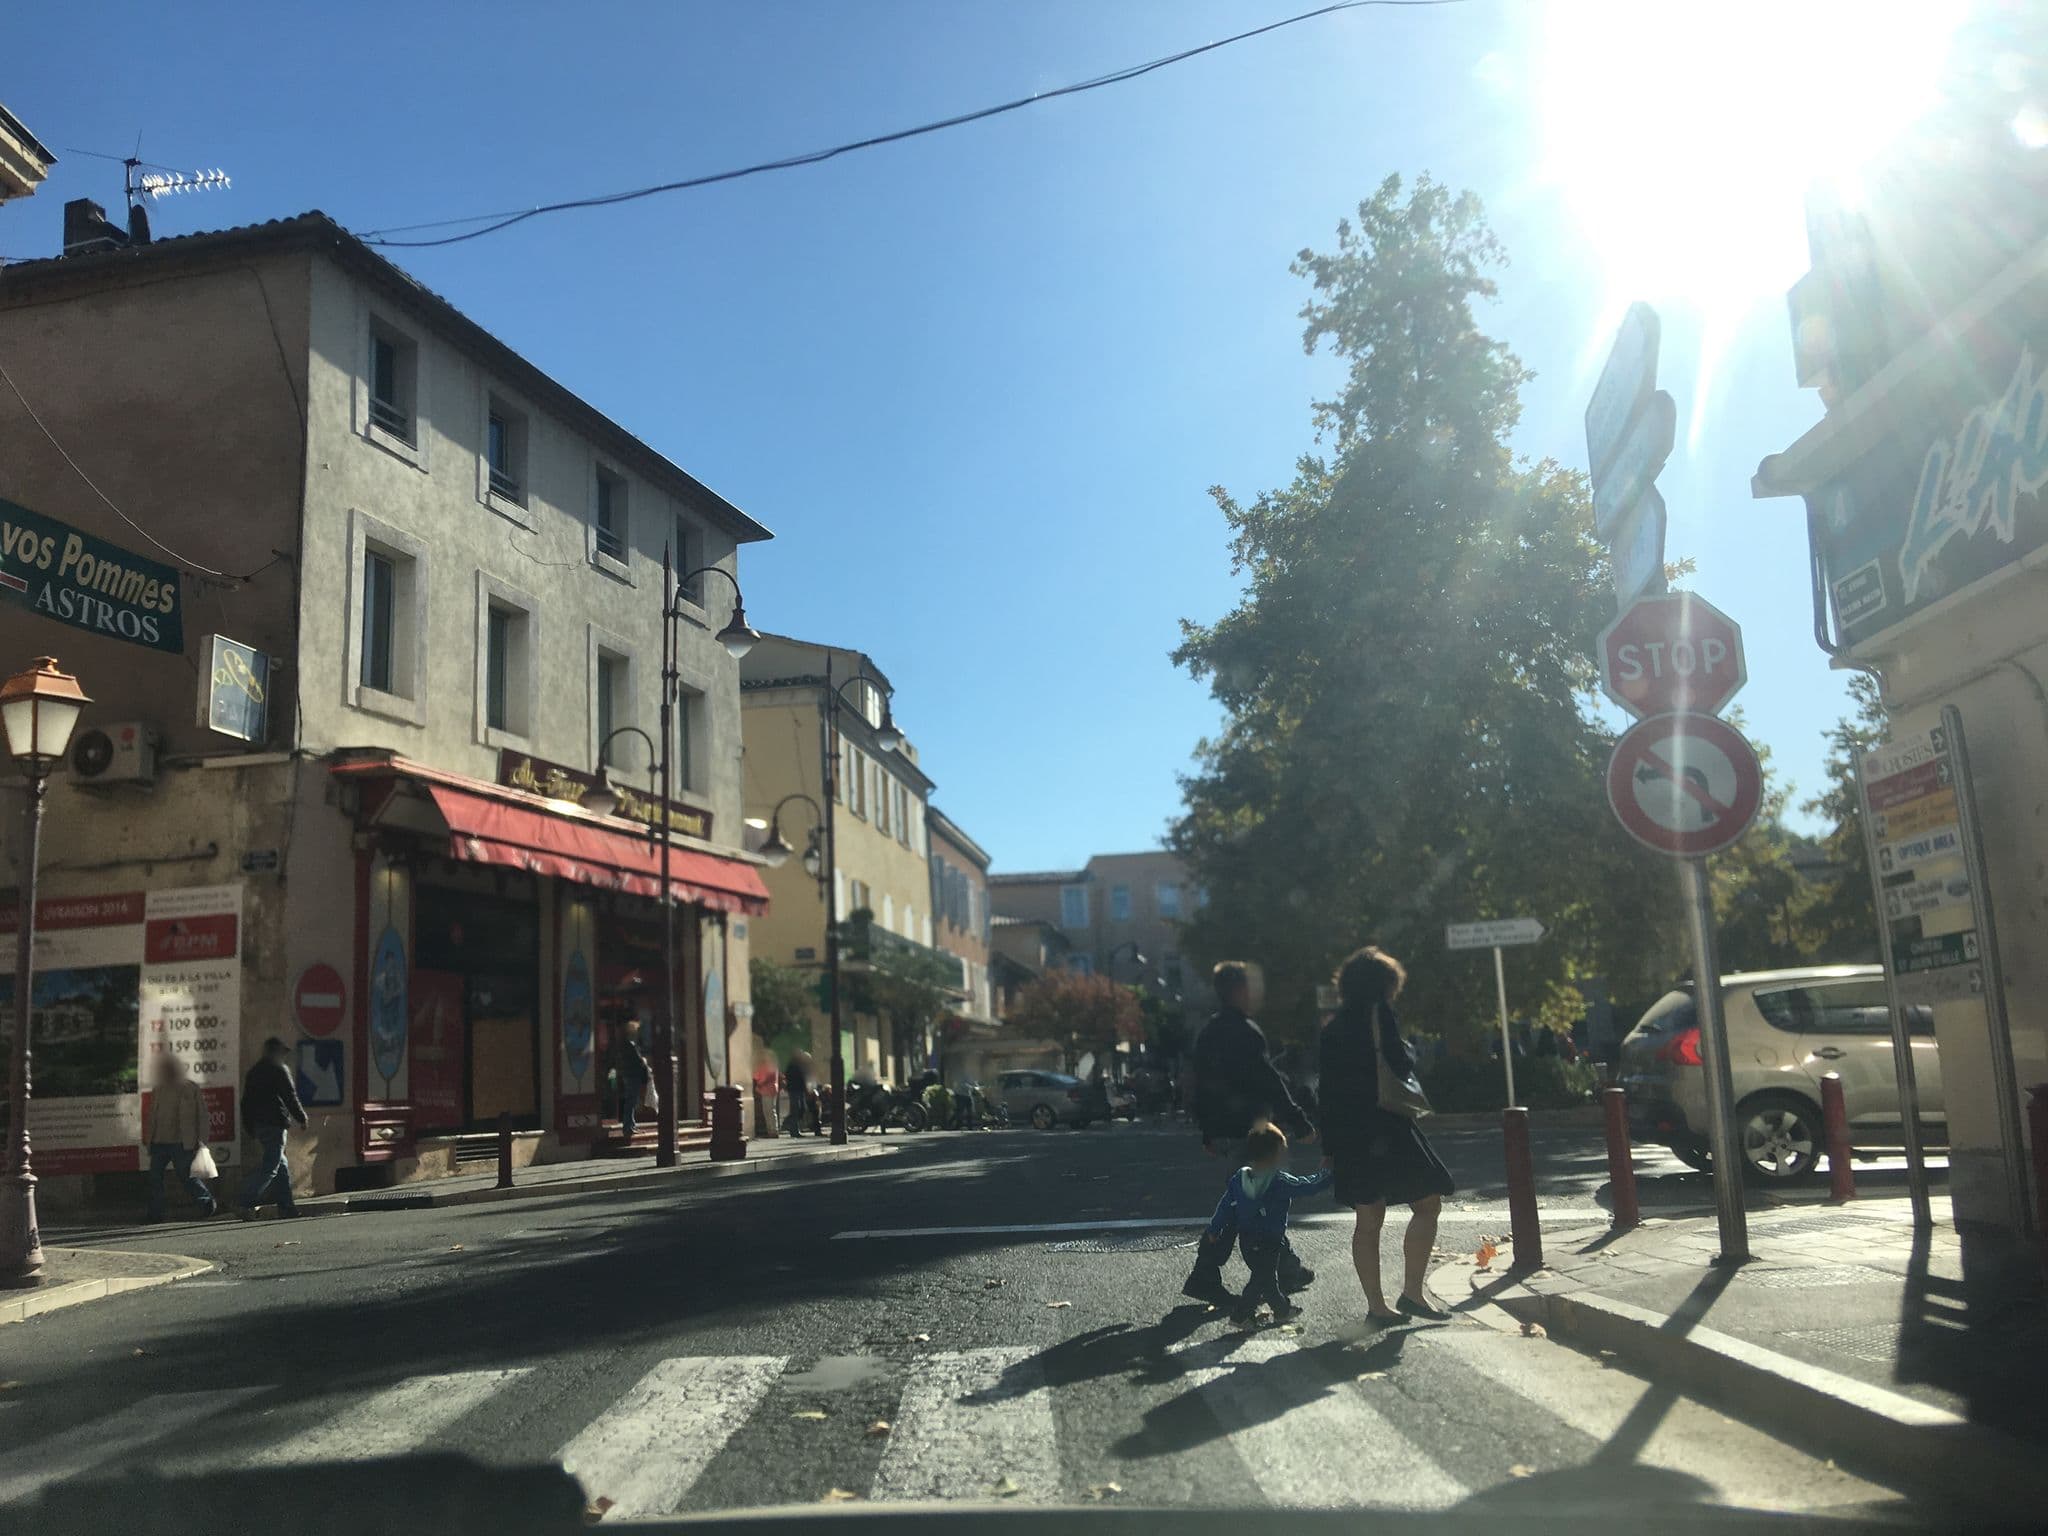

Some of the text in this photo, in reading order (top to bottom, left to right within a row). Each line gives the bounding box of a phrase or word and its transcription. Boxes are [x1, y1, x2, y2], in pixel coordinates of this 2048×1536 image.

[58, 533, 176, 614] Pommes
[35, 581, 160, 643] ASTROS
[1617, 638, 1726, 681] STOP
[168, 1017, 191, 1031] 109
[194, 1015, 218, 1029] 000
[168, 1039, 191, 1053] 159
[194, 1038, 218, 1052] 000
[193, 1060, 218, 1074] 000
